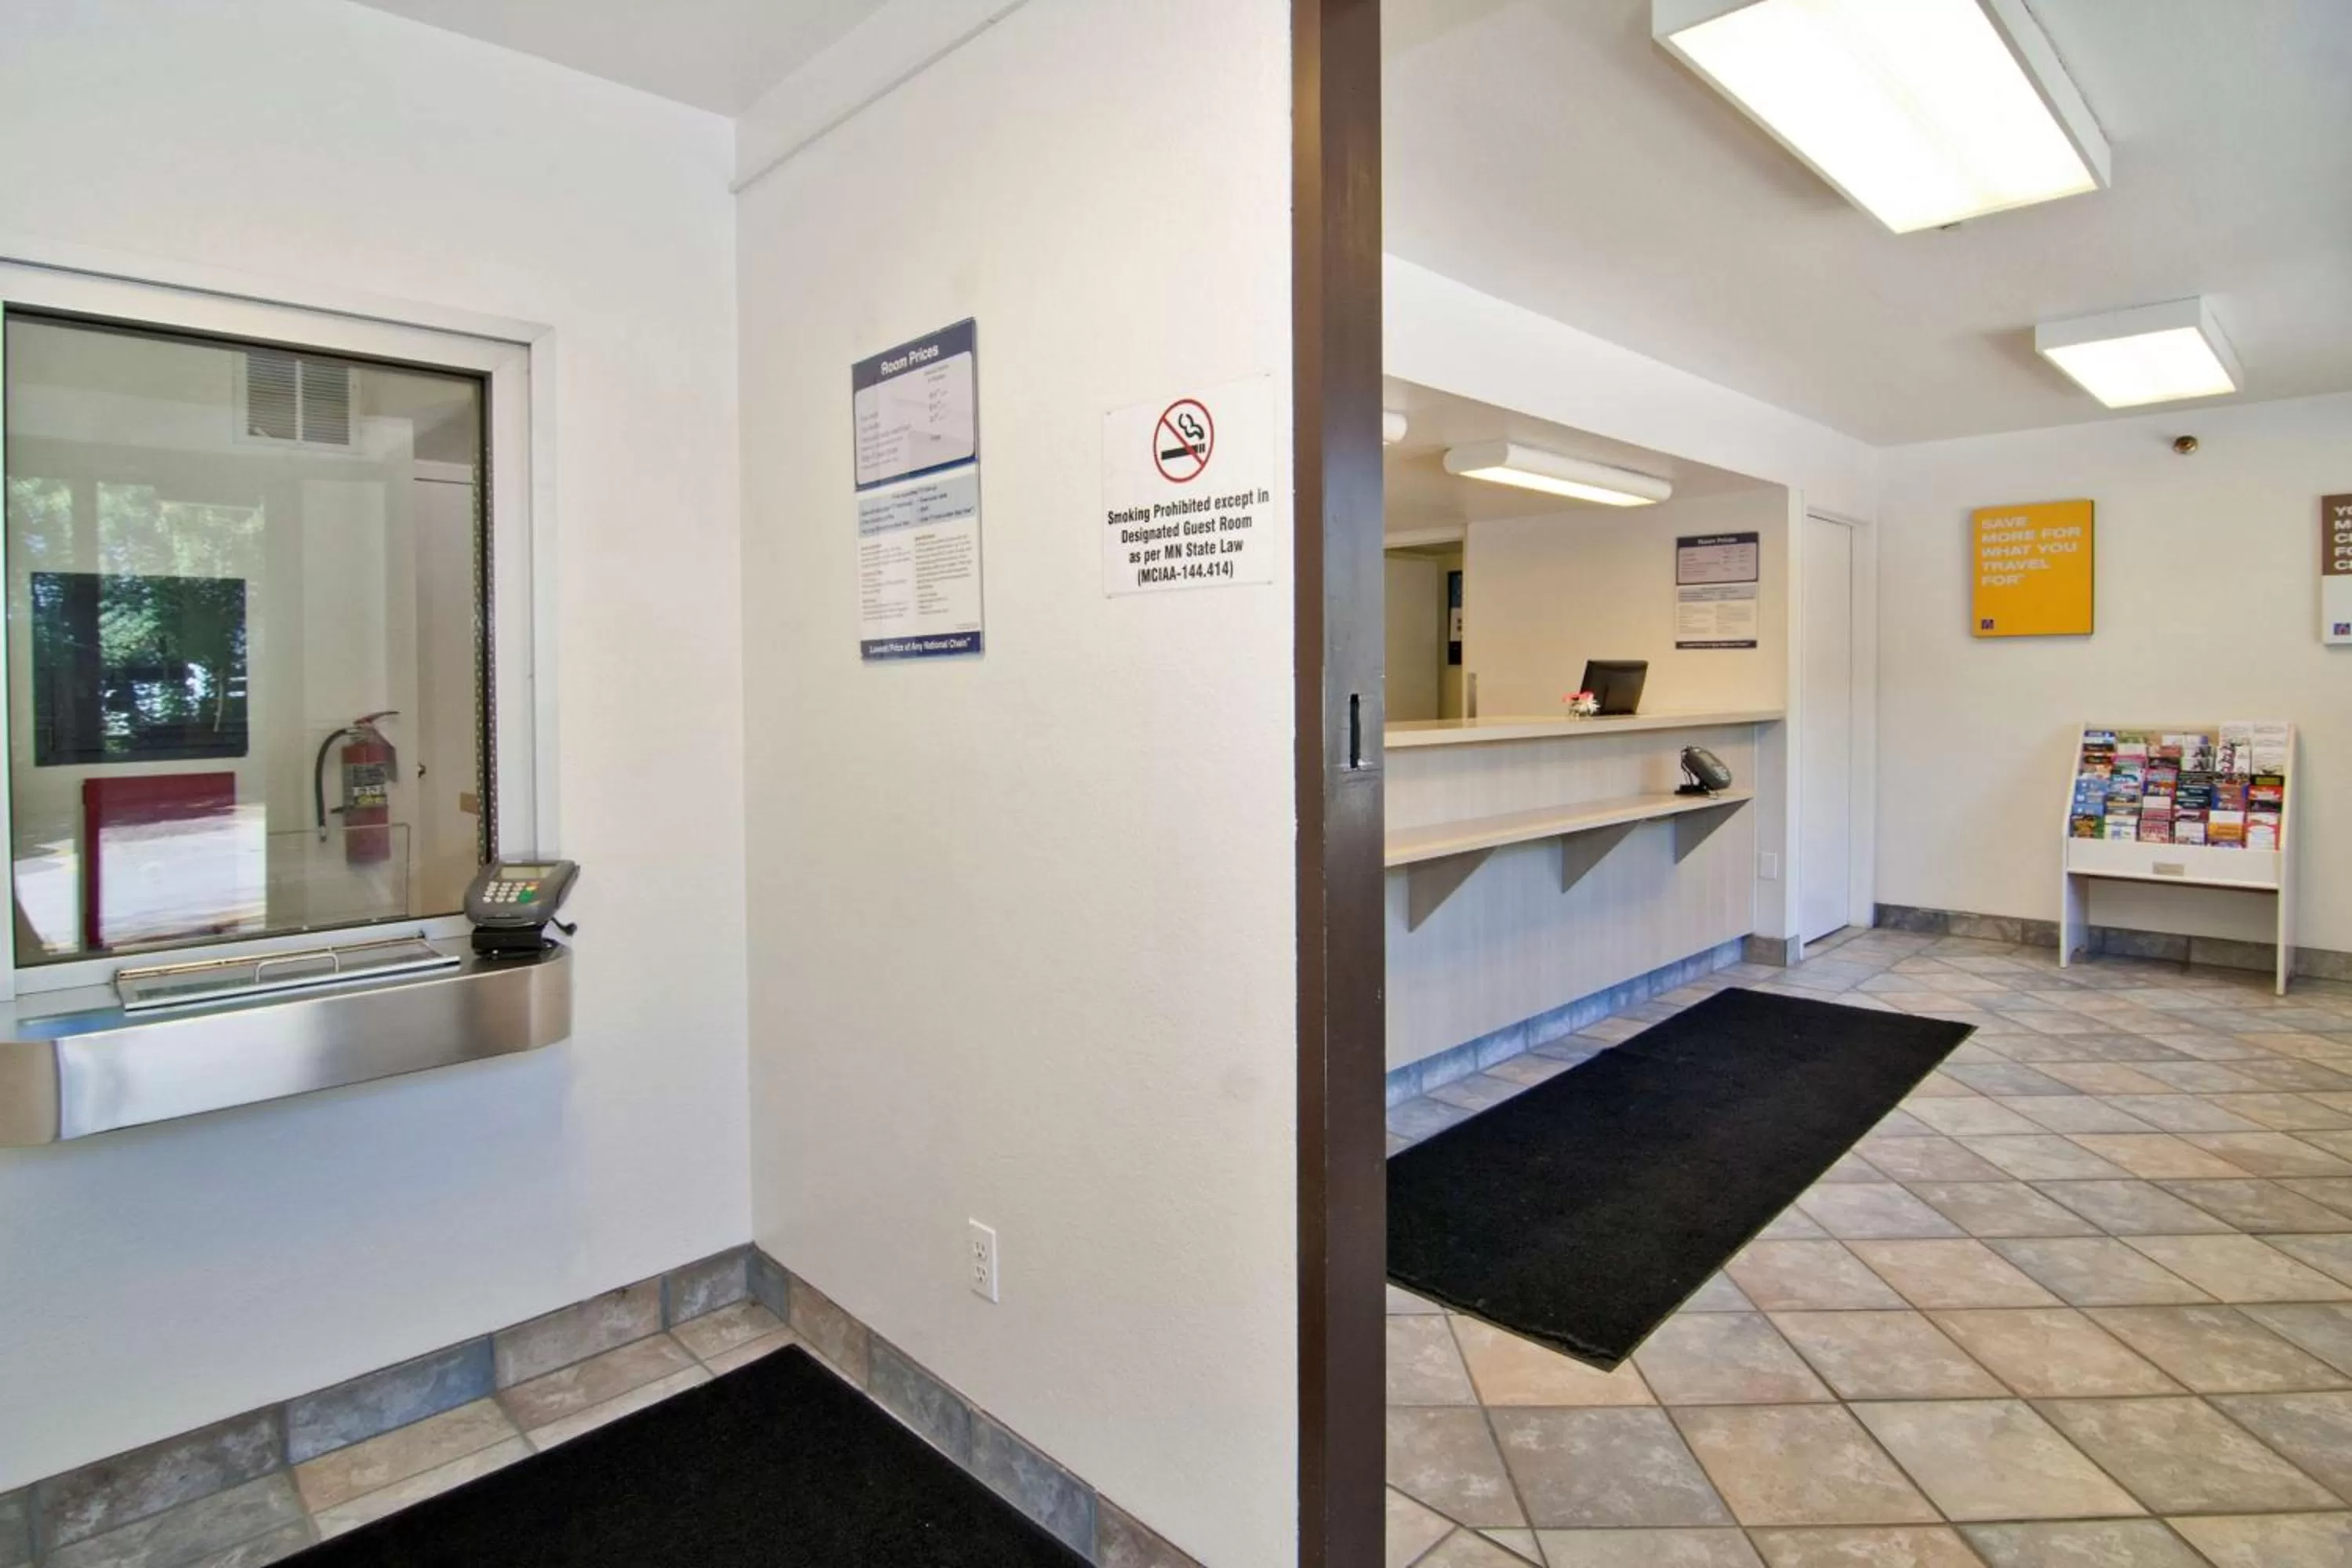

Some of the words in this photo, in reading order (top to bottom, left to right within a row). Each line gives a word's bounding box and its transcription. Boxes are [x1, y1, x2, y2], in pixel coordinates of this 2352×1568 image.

[880, 358, 908, 376] Room
[909, 345, 938, 365] Prices
[1108, 508, 1150, 525] Smoking
[1153, 497, 1210, 518] Prohibited
[1214, 489, 1254, 509] except
[1258, 488, 1269, 503] in
[1121, 524, 1180, 544] Designated
[1183, 518, 1216, 536] Guest
[1219, 515, 1253, 531] Room
[1981, 517, 2027, 529] SAVE
[1981, 530, 2034, 543] MORE
[2042, 526, 2082, 539] FOR
[1129, 551, 1141, 564] as
[1144, 549, 1160, 564] per
[1164, 545, 1182, 560] MN
[1186, 541, 1216, 557] State
[1220, 538, 1243, 554] Law
[1981, 545, 2032, 557] WHAT
[2037, 542, 2078, 554] YOU
[1138, 560, 1234, 587] (MCIAA-144.414)
[1982, 558, 2051, 572] TRAVEL
